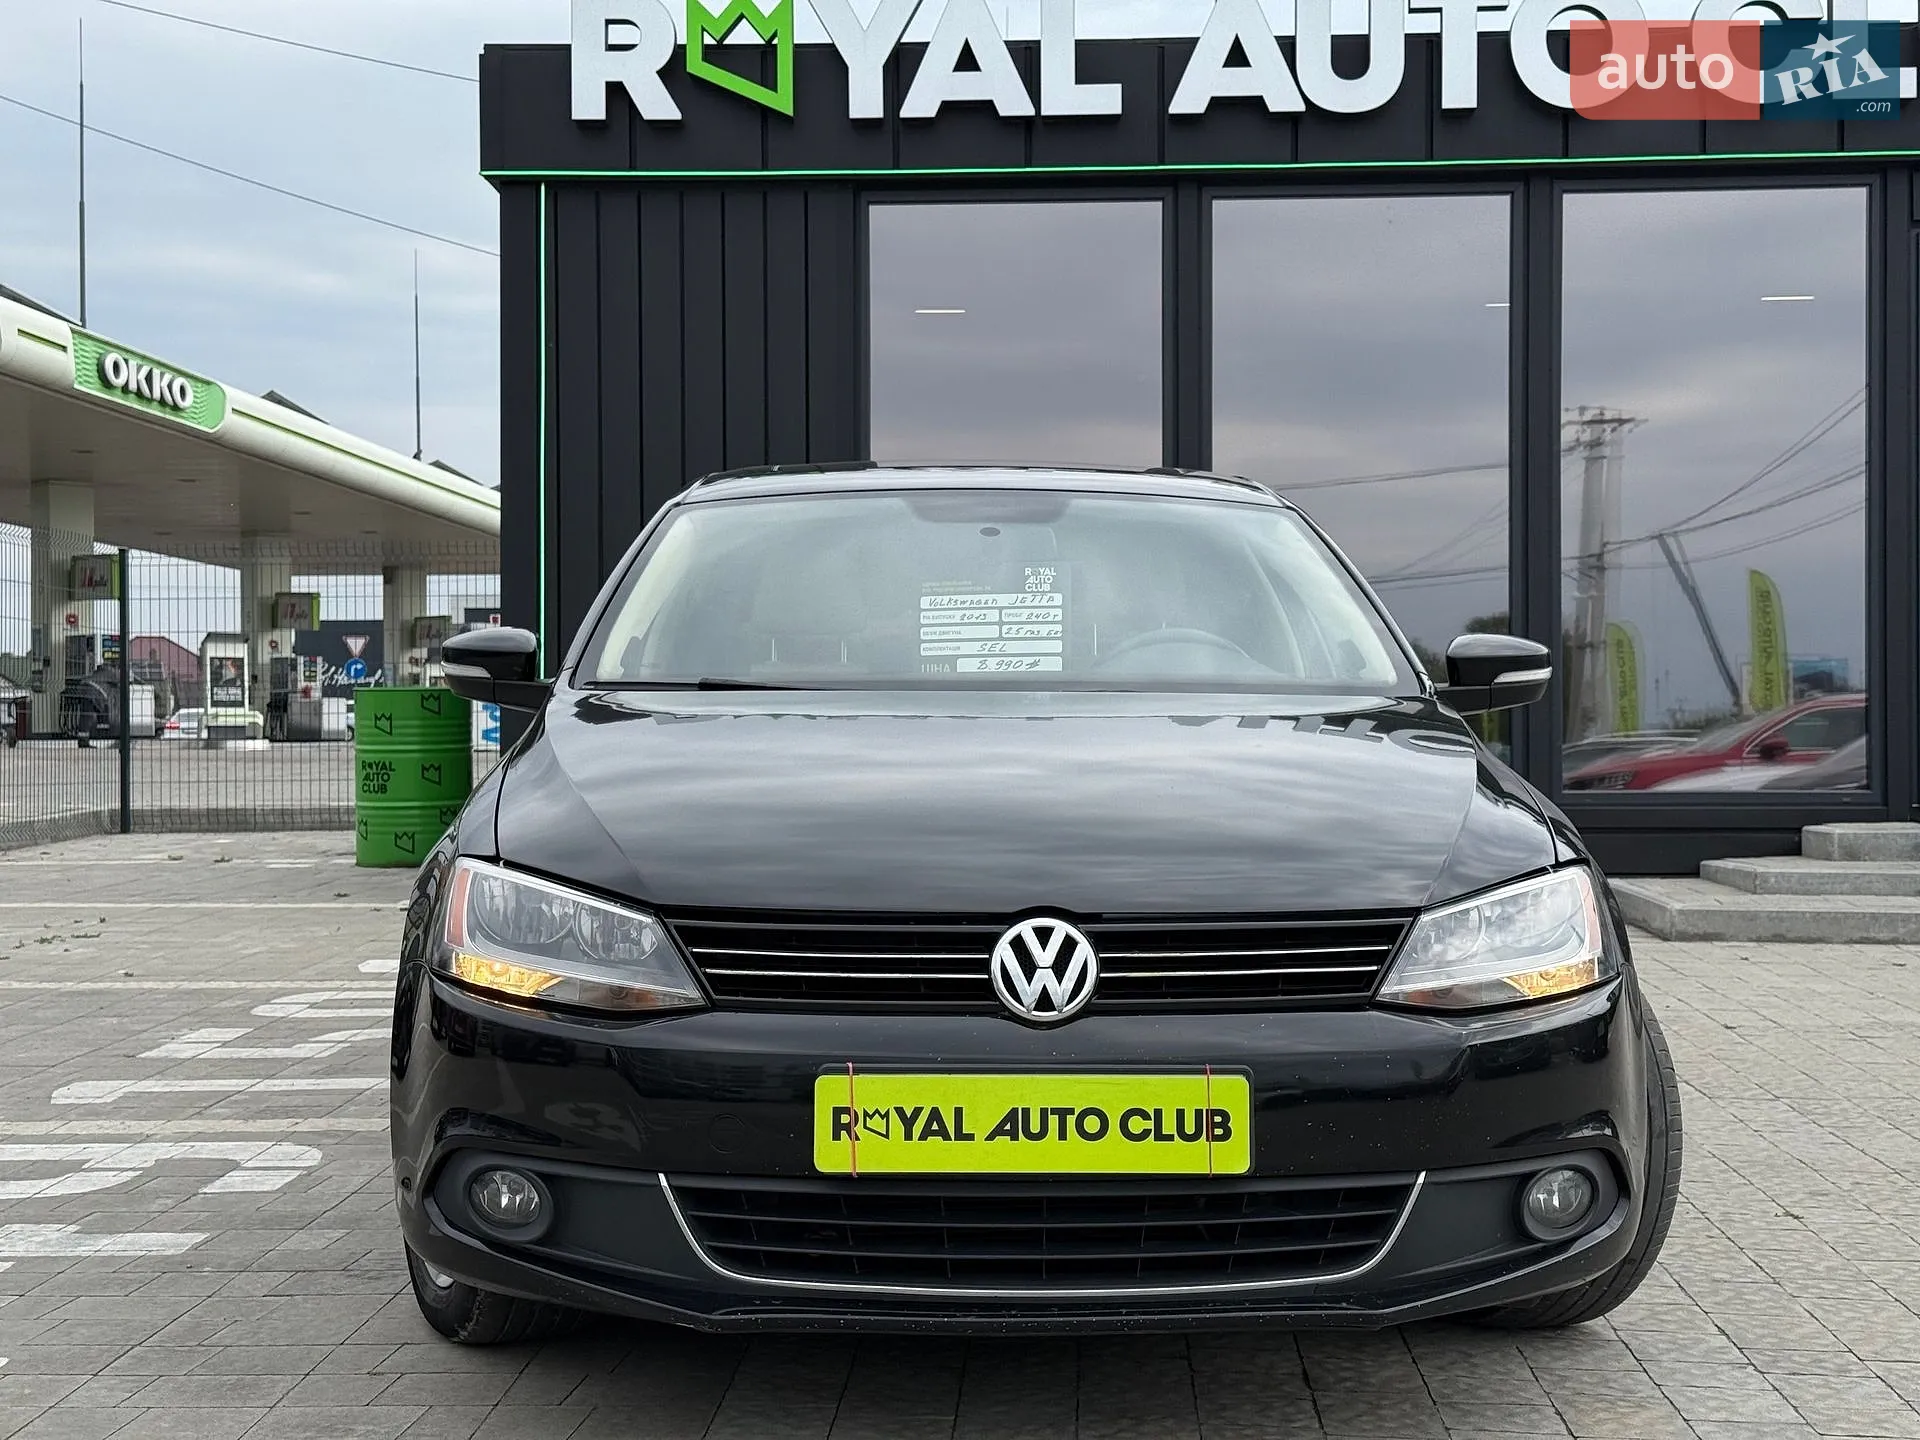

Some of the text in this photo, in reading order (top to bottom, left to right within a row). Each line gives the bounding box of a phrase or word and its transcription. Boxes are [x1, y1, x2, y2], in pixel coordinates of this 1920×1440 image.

[1169, 0, 1650, 114] AUTO
[102, 351, 194, 409] OKKO
[1025, 575, 1053, 584] AUTO
[1025, 583, 1051, 592] CLUB
[1025, 611, 1050, 620] 240
[976, 642, 1007, 653] SEL
[362, 771, 391, 783] AUTO
[361, 782, 389, 794] CLUB
[984, 1106, 1109, 1142] AUTO
[1119, 1106, 1233, 1142] CLUB
